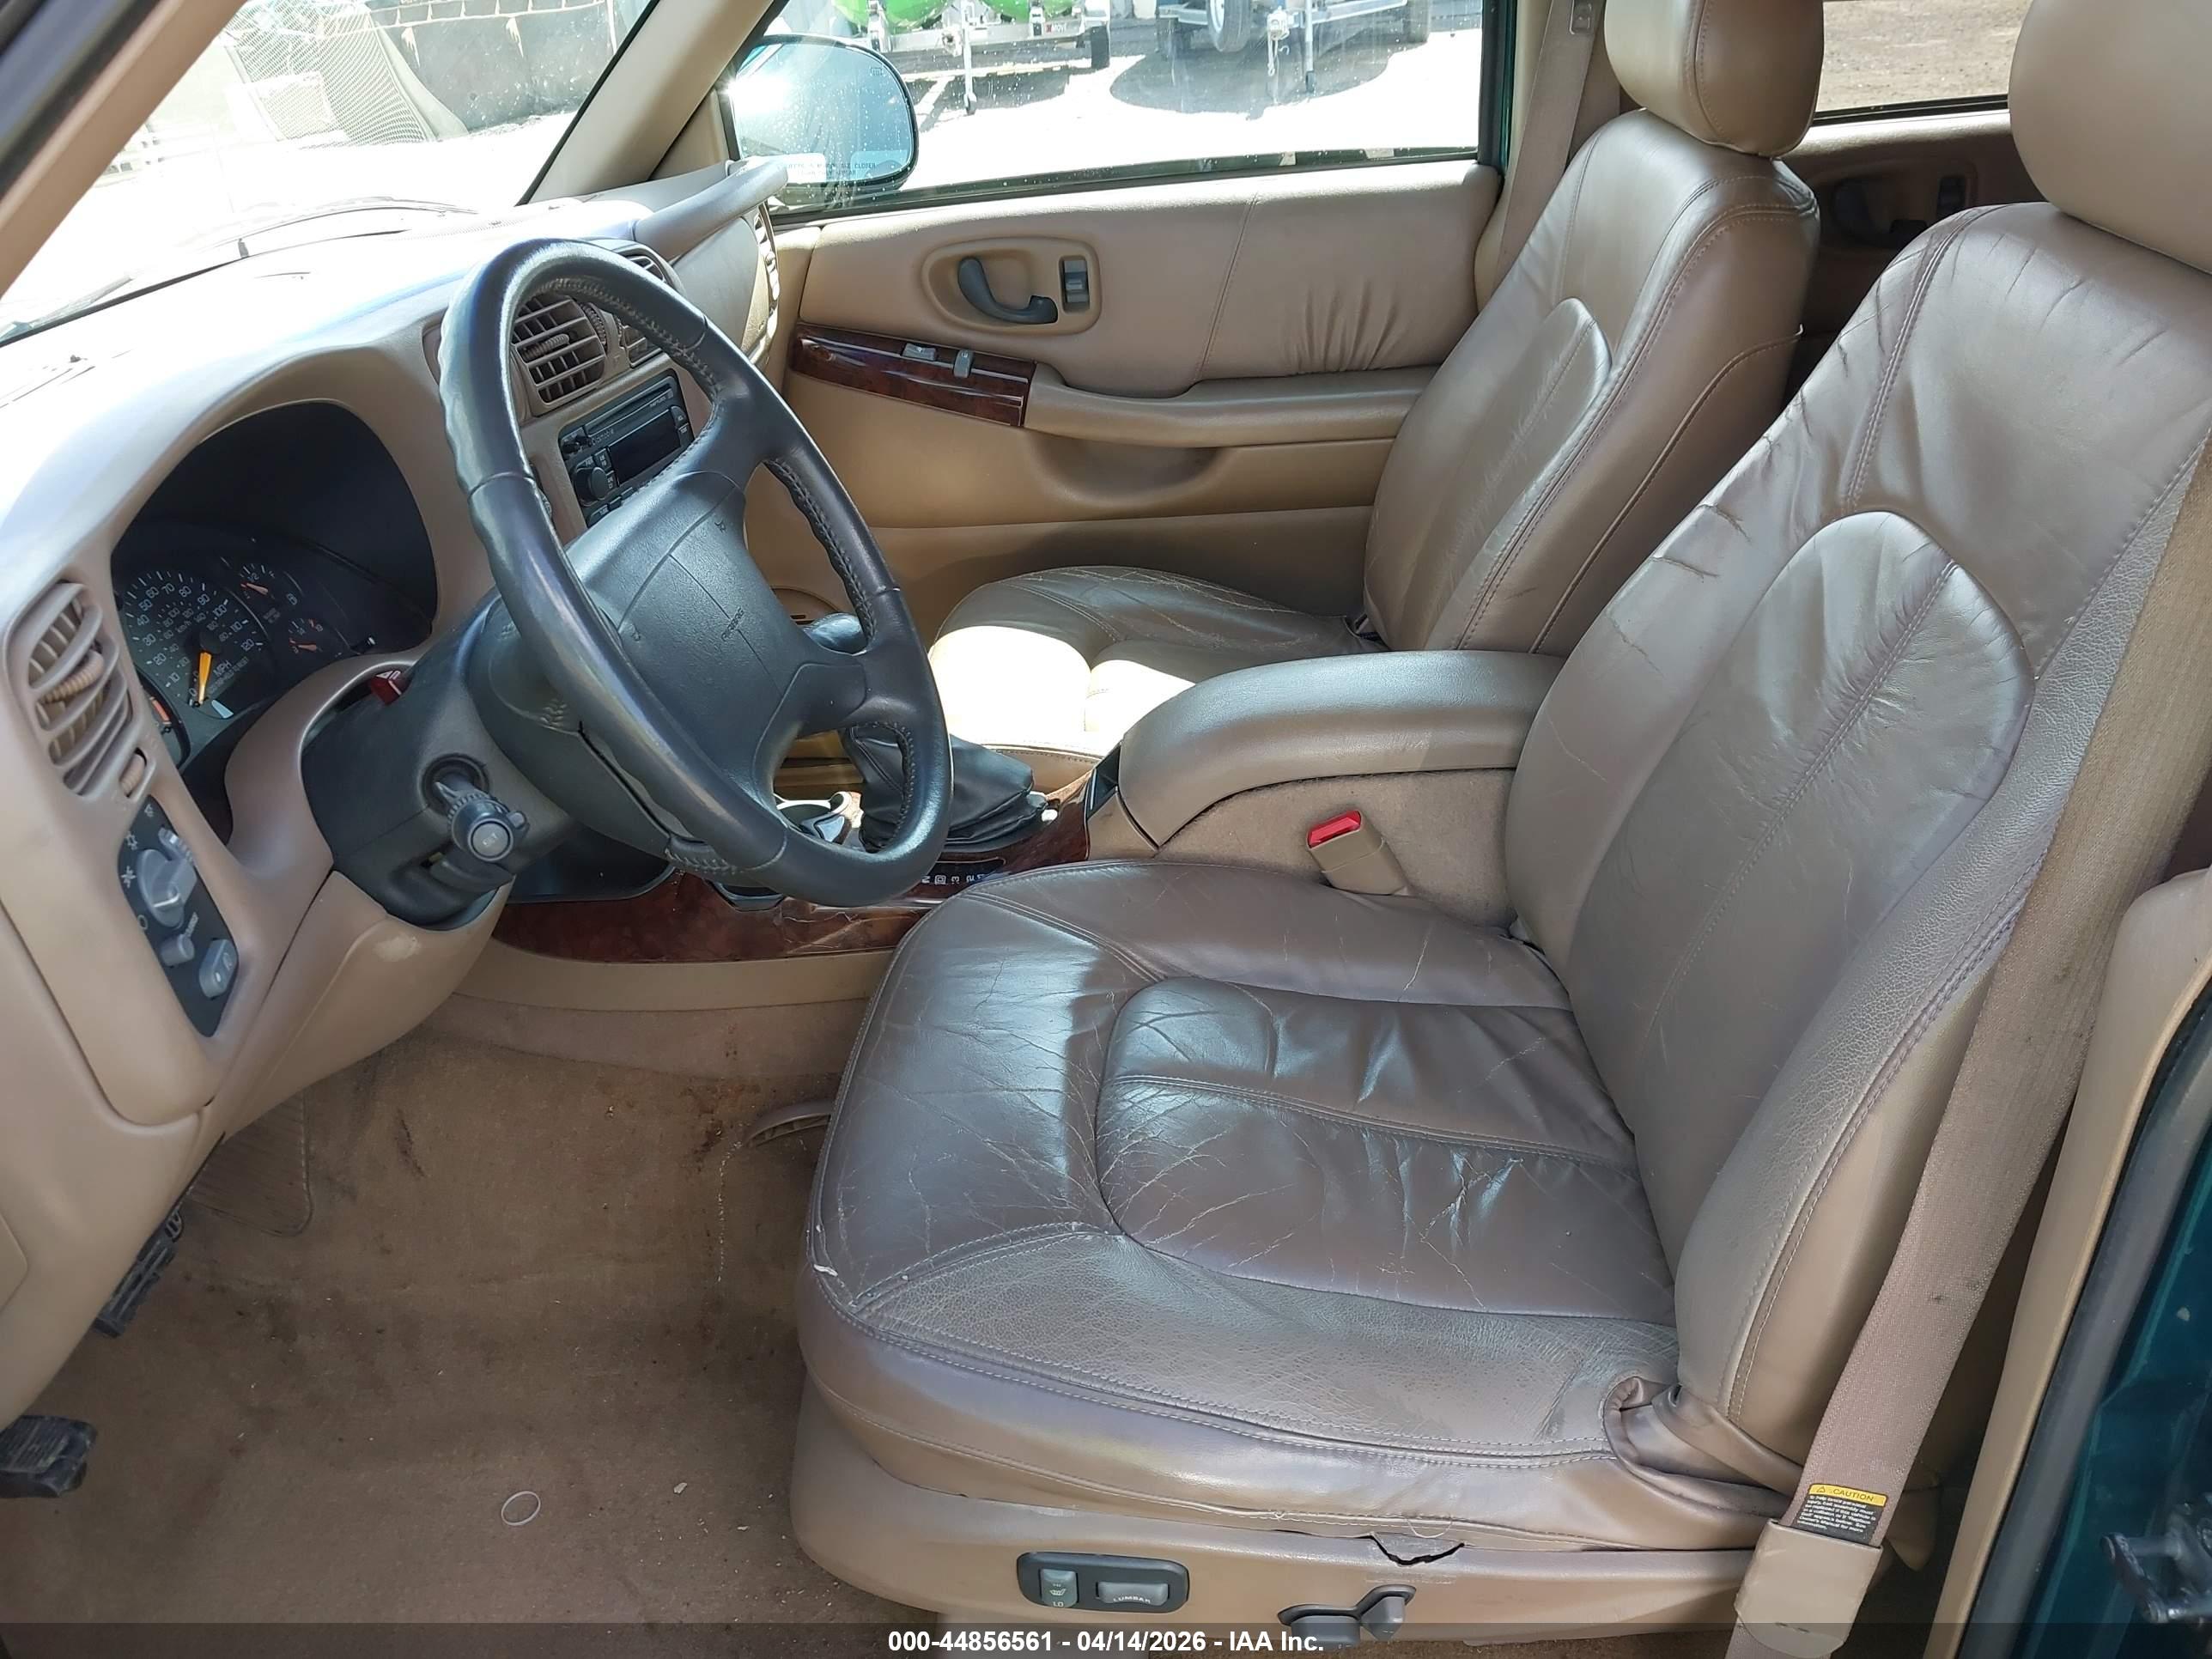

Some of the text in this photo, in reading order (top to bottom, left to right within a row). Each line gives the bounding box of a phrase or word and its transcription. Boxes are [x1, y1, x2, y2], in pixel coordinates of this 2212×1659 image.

[146, 586, 159, 598] 60
[161, 584, 174, 594] 70
[179, 586, 191, 597] 80
[139, 599, 152, 611] 50
[198, 594, 210, 605] 90
[213, 605, 227, 617] 100
[137, 615, 149, 625] 40
[230, 622, 242, 632] 110
[143, 634, 156, 646] 30
[240, 639, 254, 651] 120
[153, 653, 167, 665] 20
[213, 659, 232, 676] MPH
[169, 672, 179, 683] 10
[189, 688, 197, 696] 0
[1832, 1489, 1874, 1501] CAUTION
